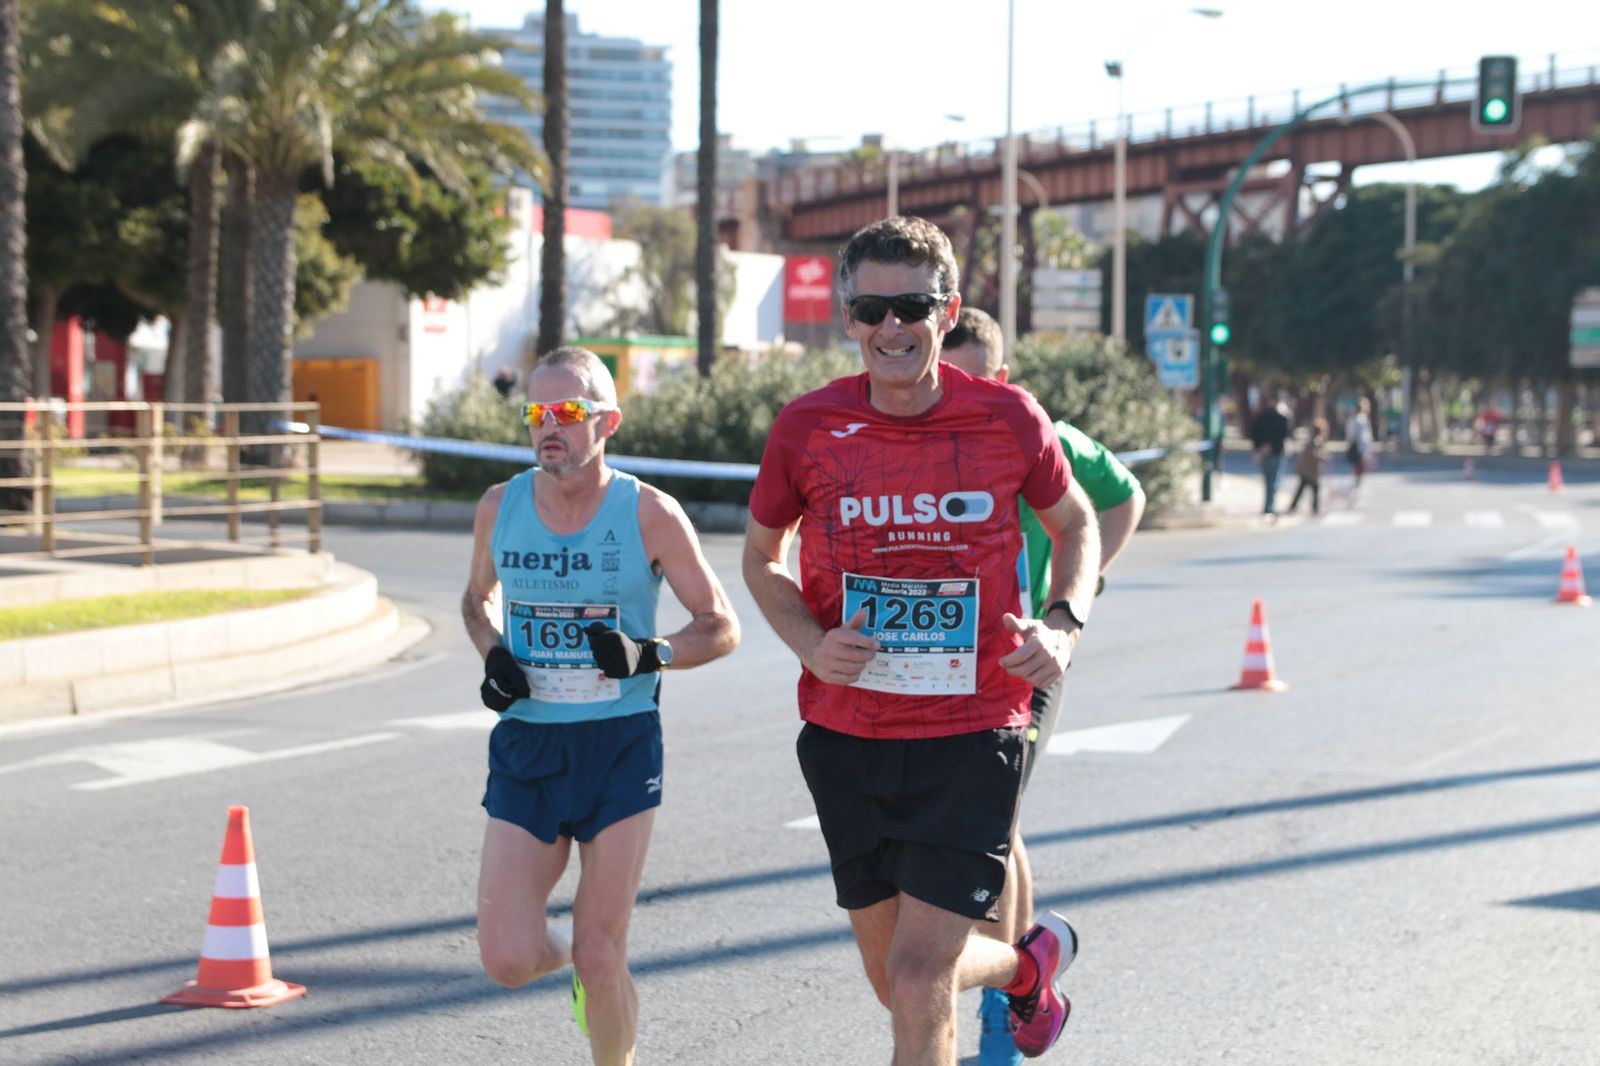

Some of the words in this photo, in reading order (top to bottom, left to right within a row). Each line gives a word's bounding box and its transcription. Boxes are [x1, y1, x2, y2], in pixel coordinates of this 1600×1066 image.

[888, 531, 951, 542] RUNNING
[501, 546, 592, 578] nerja
[512, 579, 580, 590] ATLETISMO
[860, 595, 965, 631] 1269
[873, 631, 899, 641] JOSE
[901, 632, 946, 641] CARLOS
[530, 650, 553, 659] JUAN
